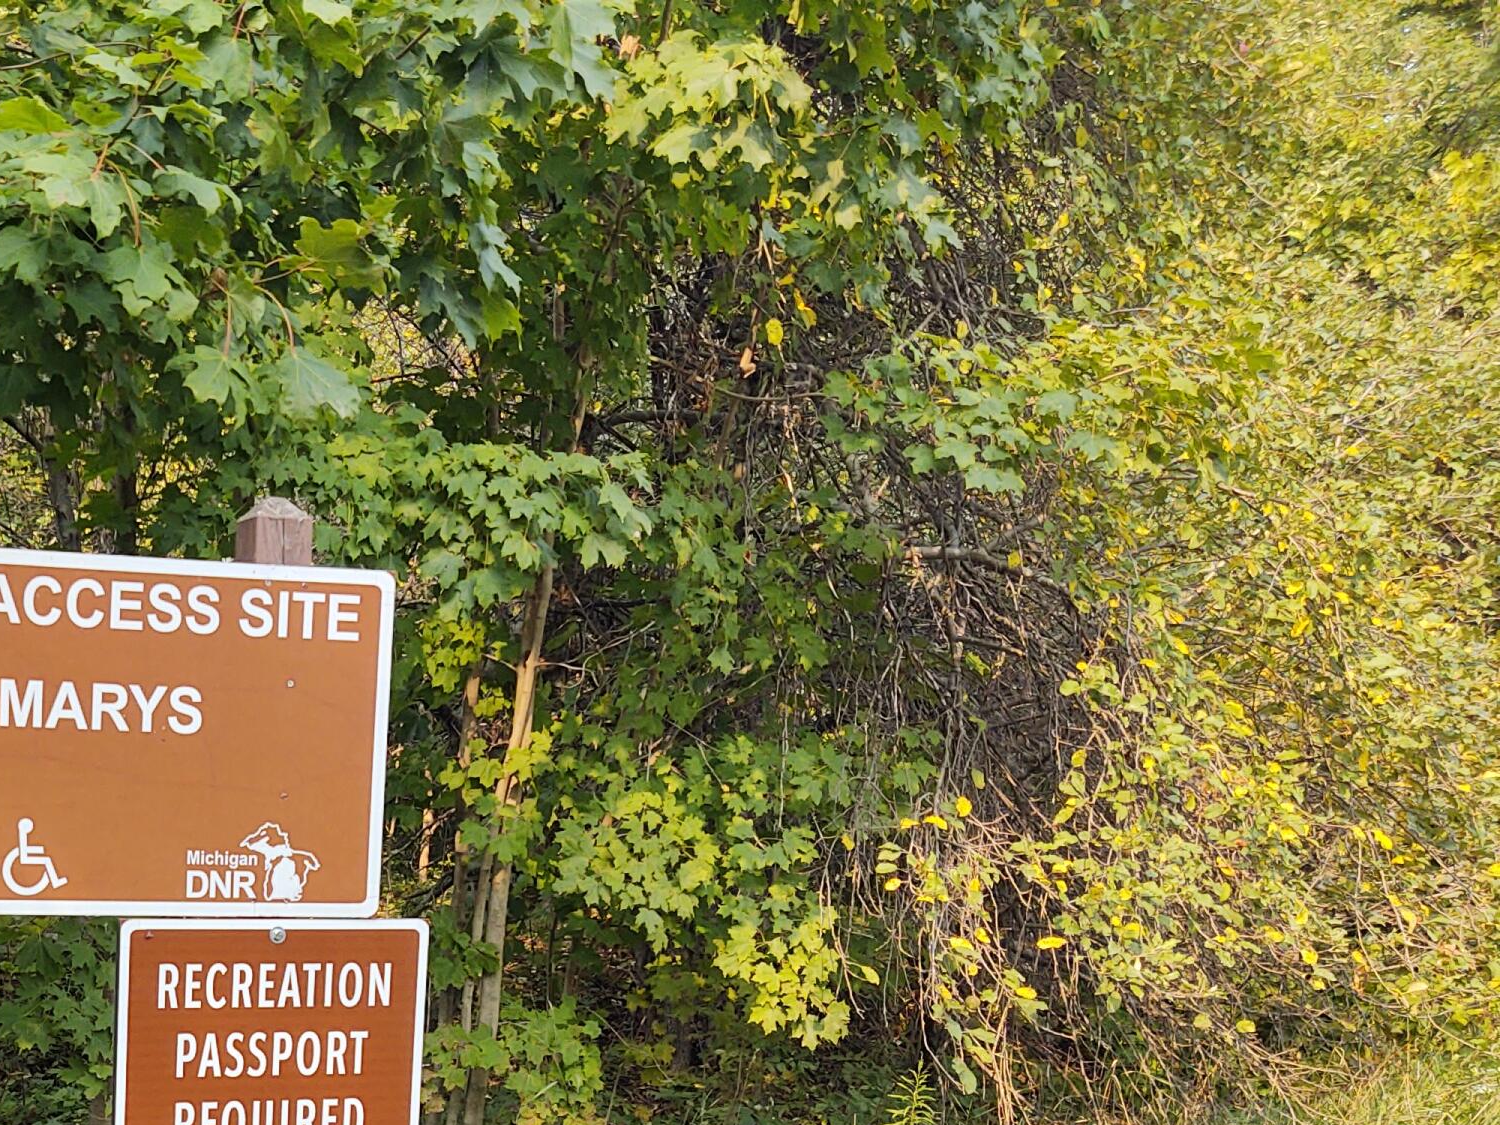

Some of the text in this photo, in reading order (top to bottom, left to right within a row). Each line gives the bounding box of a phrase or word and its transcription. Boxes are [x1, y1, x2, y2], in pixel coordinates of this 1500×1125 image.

[238, 588, 361, 642] SITE
[186, 849, 258, 870] Michigan
[185, 869, 257, 900] DNR
[157, 962, 392, 1009] RECREATION
[175, 1030, 369, 1078] PASSPORT
